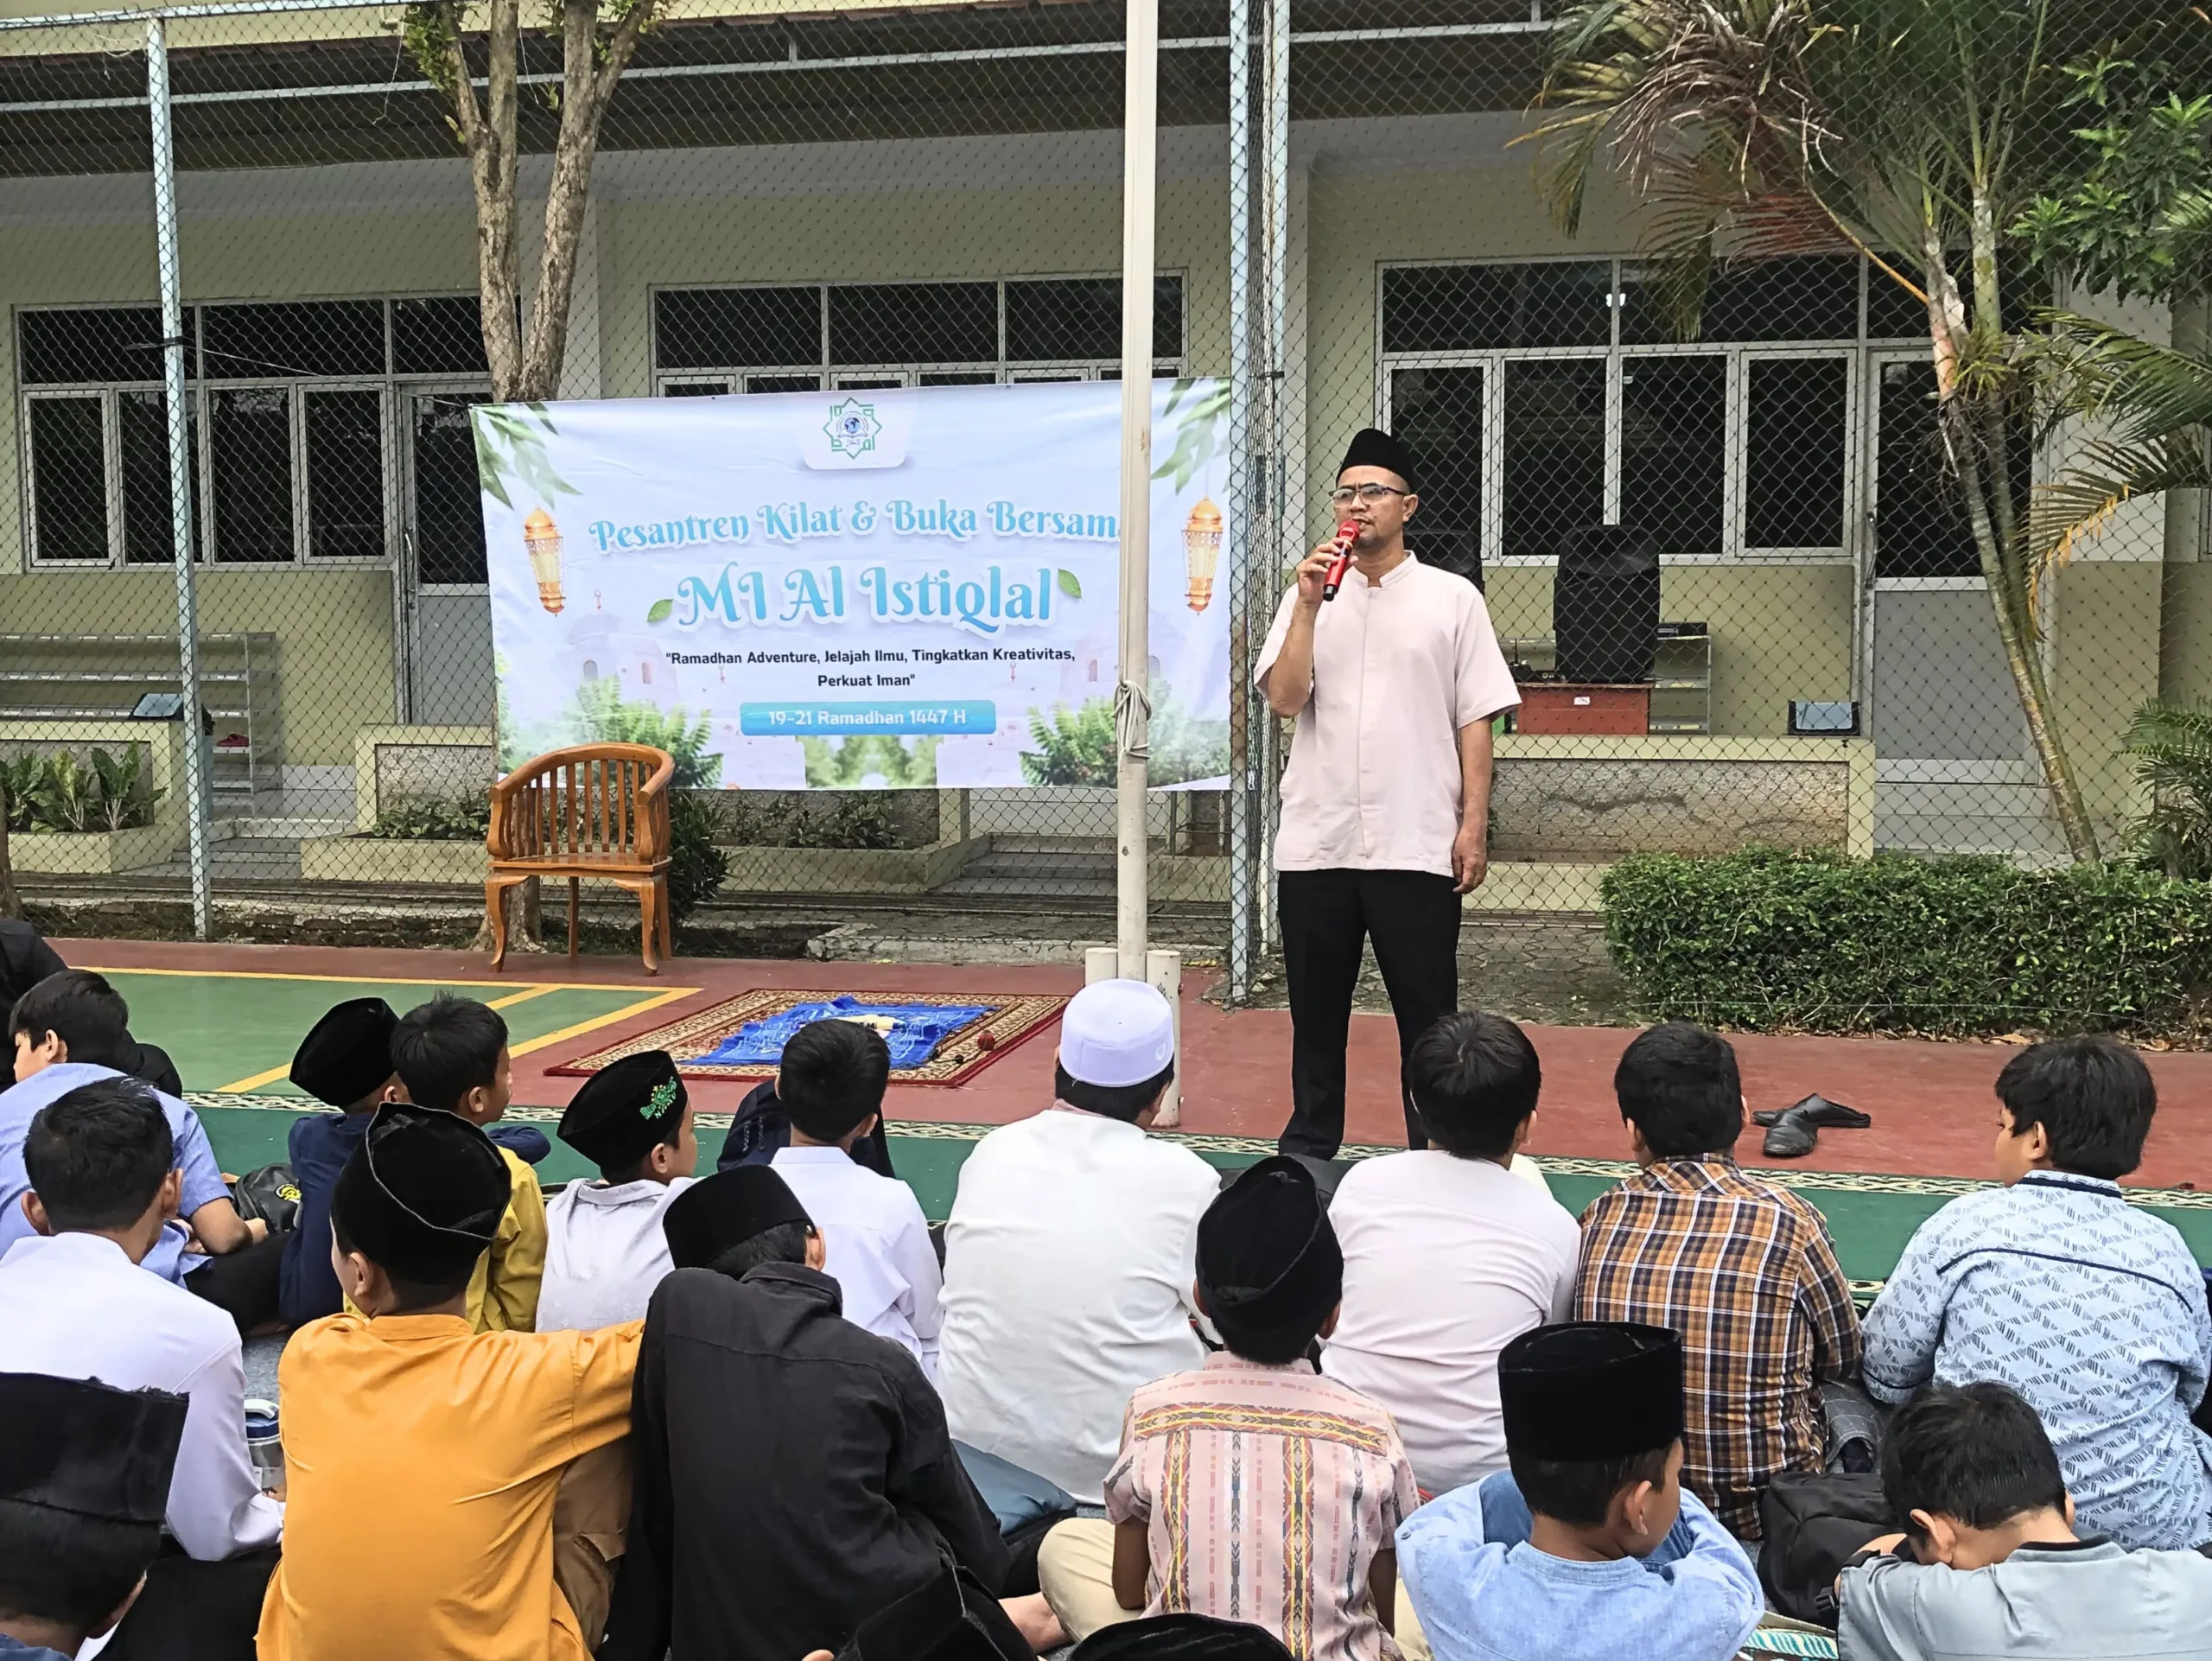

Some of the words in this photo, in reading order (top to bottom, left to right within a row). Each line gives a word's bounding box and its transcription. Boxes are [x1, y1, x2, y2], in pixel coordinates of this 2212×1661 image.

[588, 513, 749, 551] Pesantren
[757, 501, 842, 540] Kilat
[851, 500, 876, 531] &
[886, 499, 978, 538] Buka
[986, 500, 1120, 538] Bersam
[677, 561, 766, 626] MI
[779, 565, 844, 621] Al
[665, 652, 742, 665] "Ramadhan
[747, 651, 820, 665] Adventure,
[825, 650, 870, 665] Jelajah
[875, 649, 907, 663] Ilmu,
[912, 648, 988, 665] Tingkatkan
[993, 647, 1075, 662] Kreativitas,
[817, 674, 873, 687] Perkuat
[877, 674, 915, 686] Iman"
[769, 710, 812, 726] 19-21
[817, 710, 904, 726] Ramadhan
[909, 709, 948, 724] 1447
[954, 709, 966, 724] H
